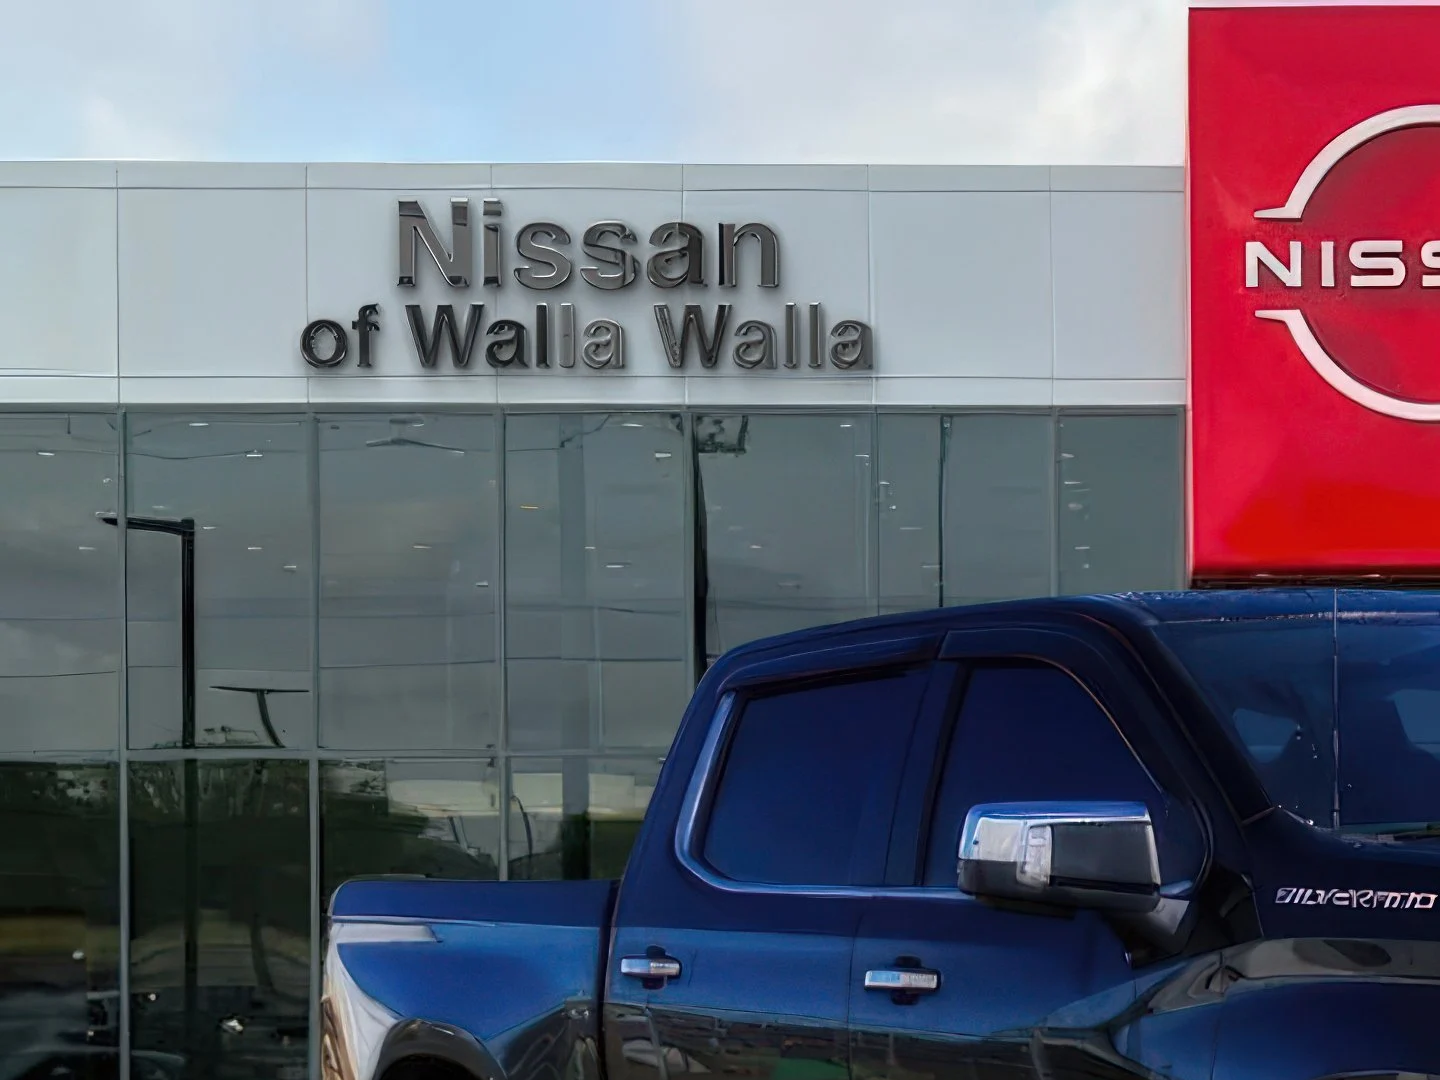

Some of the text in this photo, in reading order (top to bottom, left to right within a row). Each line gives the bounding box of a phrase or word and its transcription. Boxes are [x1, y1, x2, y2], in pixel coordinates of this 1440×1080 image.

[397, 198, 779, 290] Nissan
[300, 302, 874, 370] of Walla Walla
